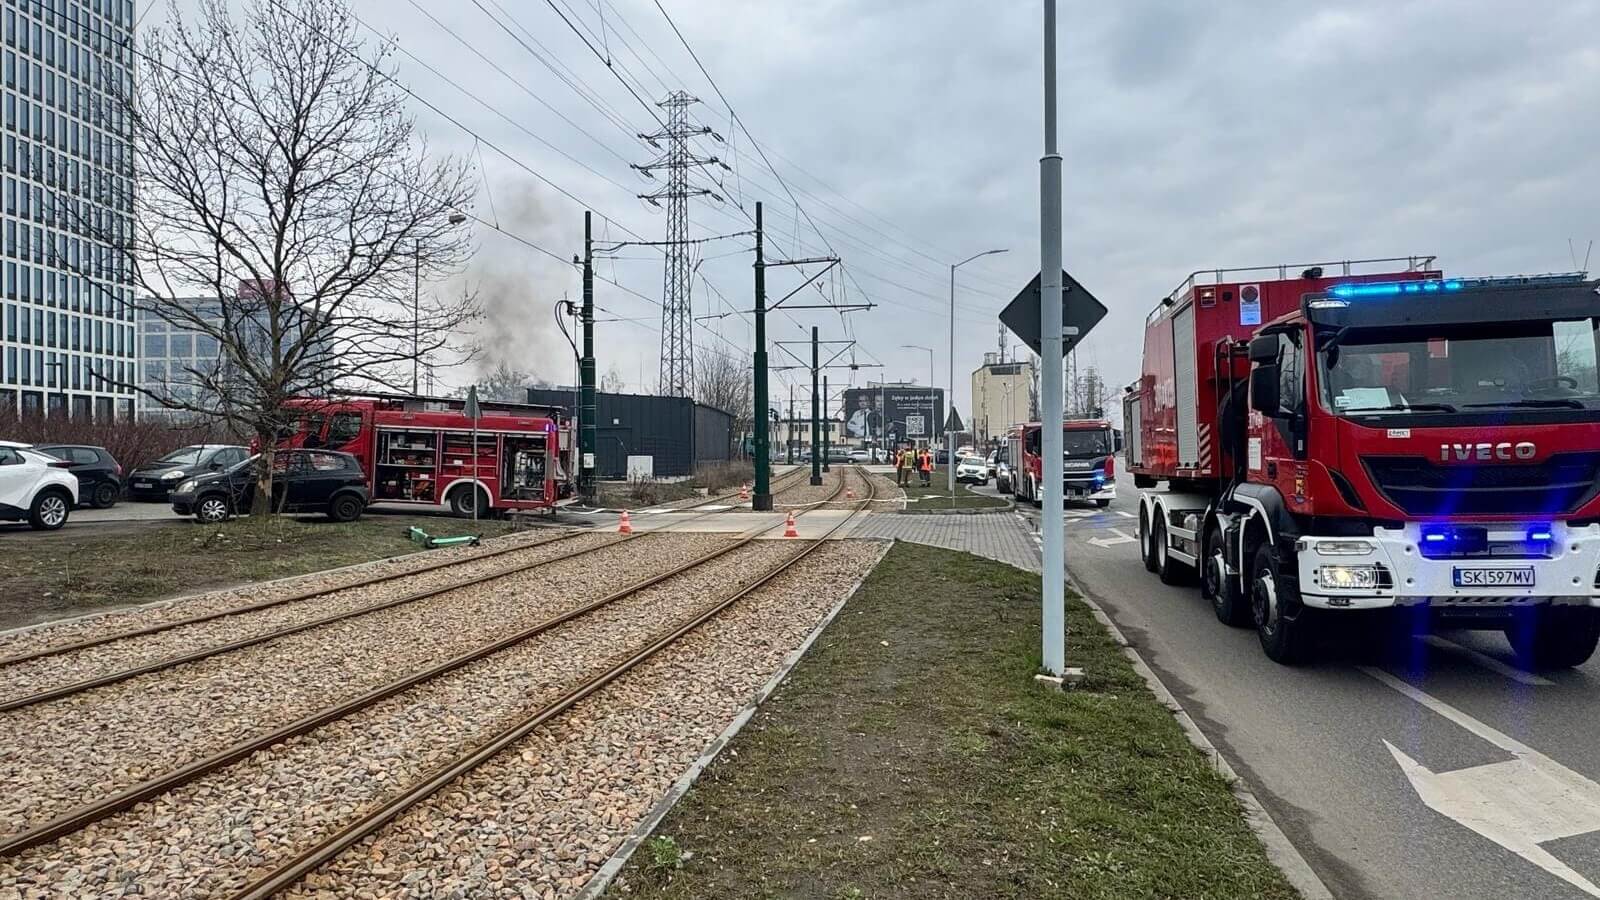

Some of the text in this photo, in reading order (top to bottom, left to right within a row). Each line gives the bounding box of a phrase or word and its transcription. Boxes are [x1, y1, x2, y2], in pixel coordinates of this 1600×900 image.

[1441, 442, 1536, 460] IVECO
[1463, 571, 1531, 583] SK 597MV
